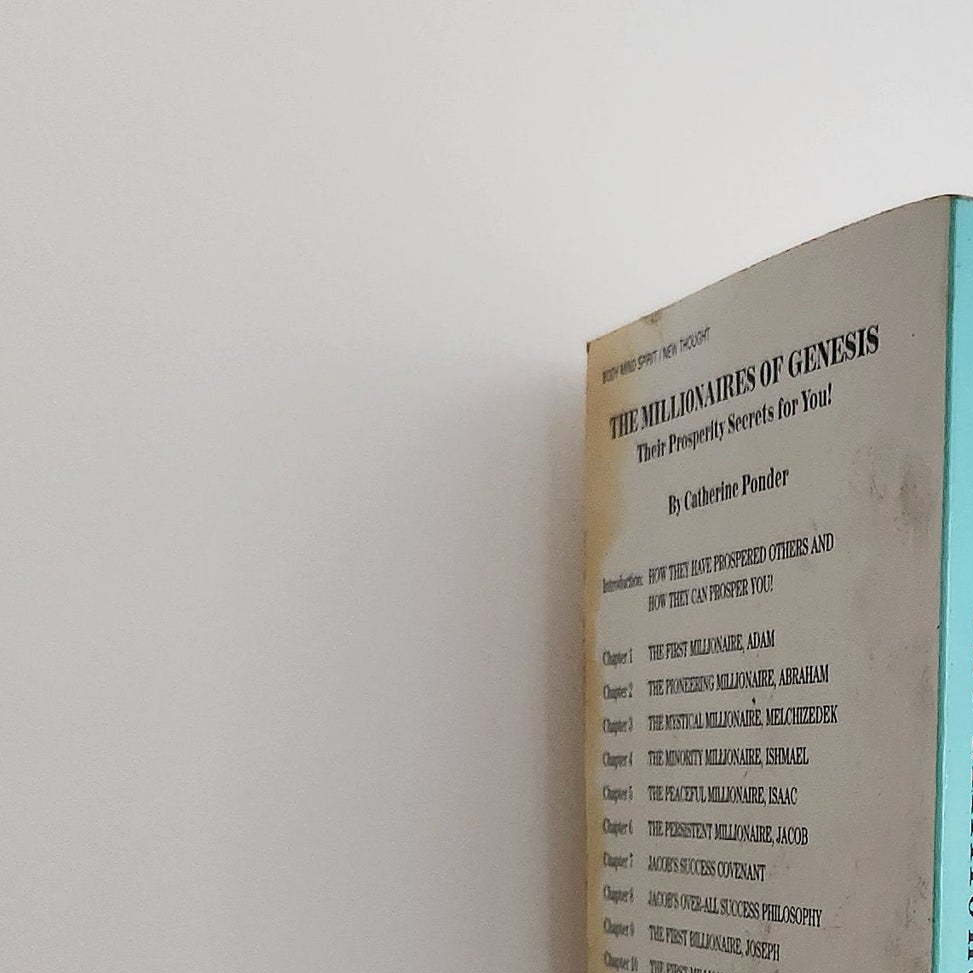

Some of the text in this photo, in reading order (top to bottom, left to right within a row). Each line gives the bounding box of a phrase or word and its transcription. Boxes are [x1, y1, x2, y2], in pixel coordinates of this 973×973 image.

[610, 324, 879, 440] THE MILLIONAIRES OF GENESIS
[637, 382, 832, 463] Their Prosperity Secrets for You!
[668, 466, 789, 516] By Catherine Ponder
[649, 566, 667, 585] HOW
[669, 562, 690, 581] THEY
[692, 558, 712, 578] HAVE
[714, 544, 766, 574] PROSPERED
[769, 537, 808, 562] OTHERS
[811, 532, 834, 554] AND
[648, 574, 774, 612] HOW THEY CAN PROSPER YOU!
[603, 651, 627, 668] Chapter
[648, 645, 664, 661] THE
[666, 641, 688, 660] FIRST
[690, 634, 745, 657] MILLIONAIRE,
[747, 630, 775, 649] ADAM
[604, 685, 627, 702] Chapter
[648, 680, 664, 696] THE
[666, 675, 714, 695] PIONEERING
[717, 669, 776, 691] MILLIONAIRE,
[779, 665, 829, 686] ABRAHAM
[604, 719, 627, 735] Chapter
[648, 715, 664, 731] THE
[665, 712, 703, 730] MYSTICAL
[706, 709, 763, 730] MILLIONAIRE,
[766, 705, 838, 726] MELCHIZEDEK
[603, 753, 627, 769] Chapter
[648, 751, 664, 765] THE
[665, 750, 703, 765] MINORITY
[705, 749, 763, 768] MILLIONAIRE,
[766, 747, 809, 765] ISHMAEL
[603, 786, 627, 802] Chapter
[648, 786, 663, 800] THE
[665, 786, 706, 801] PEACEFUL
[708, 786, 766, 807] MILLIONAIRE,
[769, 787, 797, 805] ISAAC
[603, 818, 628, 836] Chapter
[648, 820, 663, 836] THE
[665, 821, 713, 839] PERSISTENT
[714, 824, 774, 846] MILLIONAIRE,
[776, 827, 808, 845] JACOB
[604, 853, 628, 872] Chapter
[680, 858, 716, 877] SUCCESS
[718, 861, 766, 882] COVENANT
[604, 885, 628, 903] Chapter
[681, 894, 719, 914] OVER-ALL
[720, 900, 759, 920] SUCCESS
[762, 903, 822, 927] PHILOSOPHY
[604, 918, 628, 938] Chapter
[650, 925, 664, 942] THE
[666, 928, 687, 946] FIRST
[690, 931, 743, 957] BILLIONAIRE,
[745, 940, 780, 961] JOSEPH
[604, 952, 629, 973] Chapter
